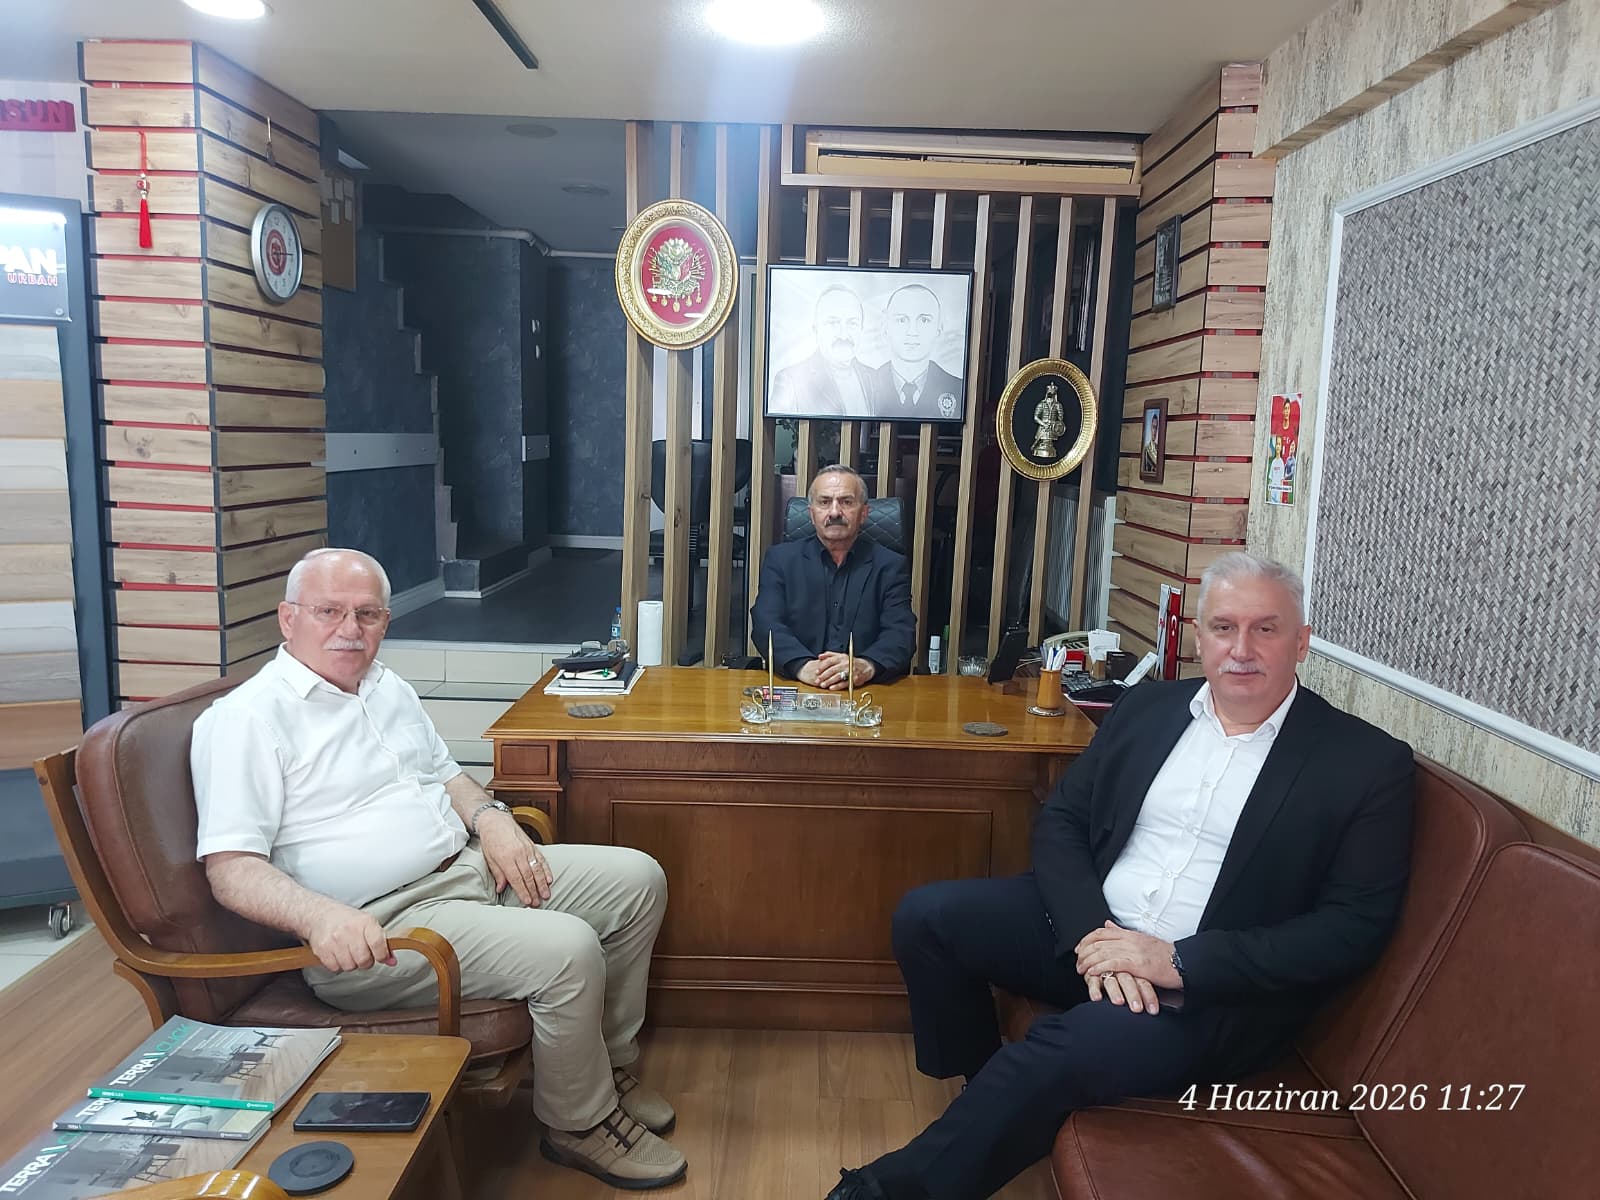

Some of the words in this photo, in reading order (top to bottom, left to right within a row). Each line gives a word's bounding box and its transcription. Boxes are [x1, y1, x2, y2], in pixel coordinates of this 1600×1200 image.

[0, 98, 76, 132] SUN
[8, 272, 58, 287] URBAN
[108, 1058, 158, 1086] TERRA
[0, 1153, 58, 1192] TERRA
